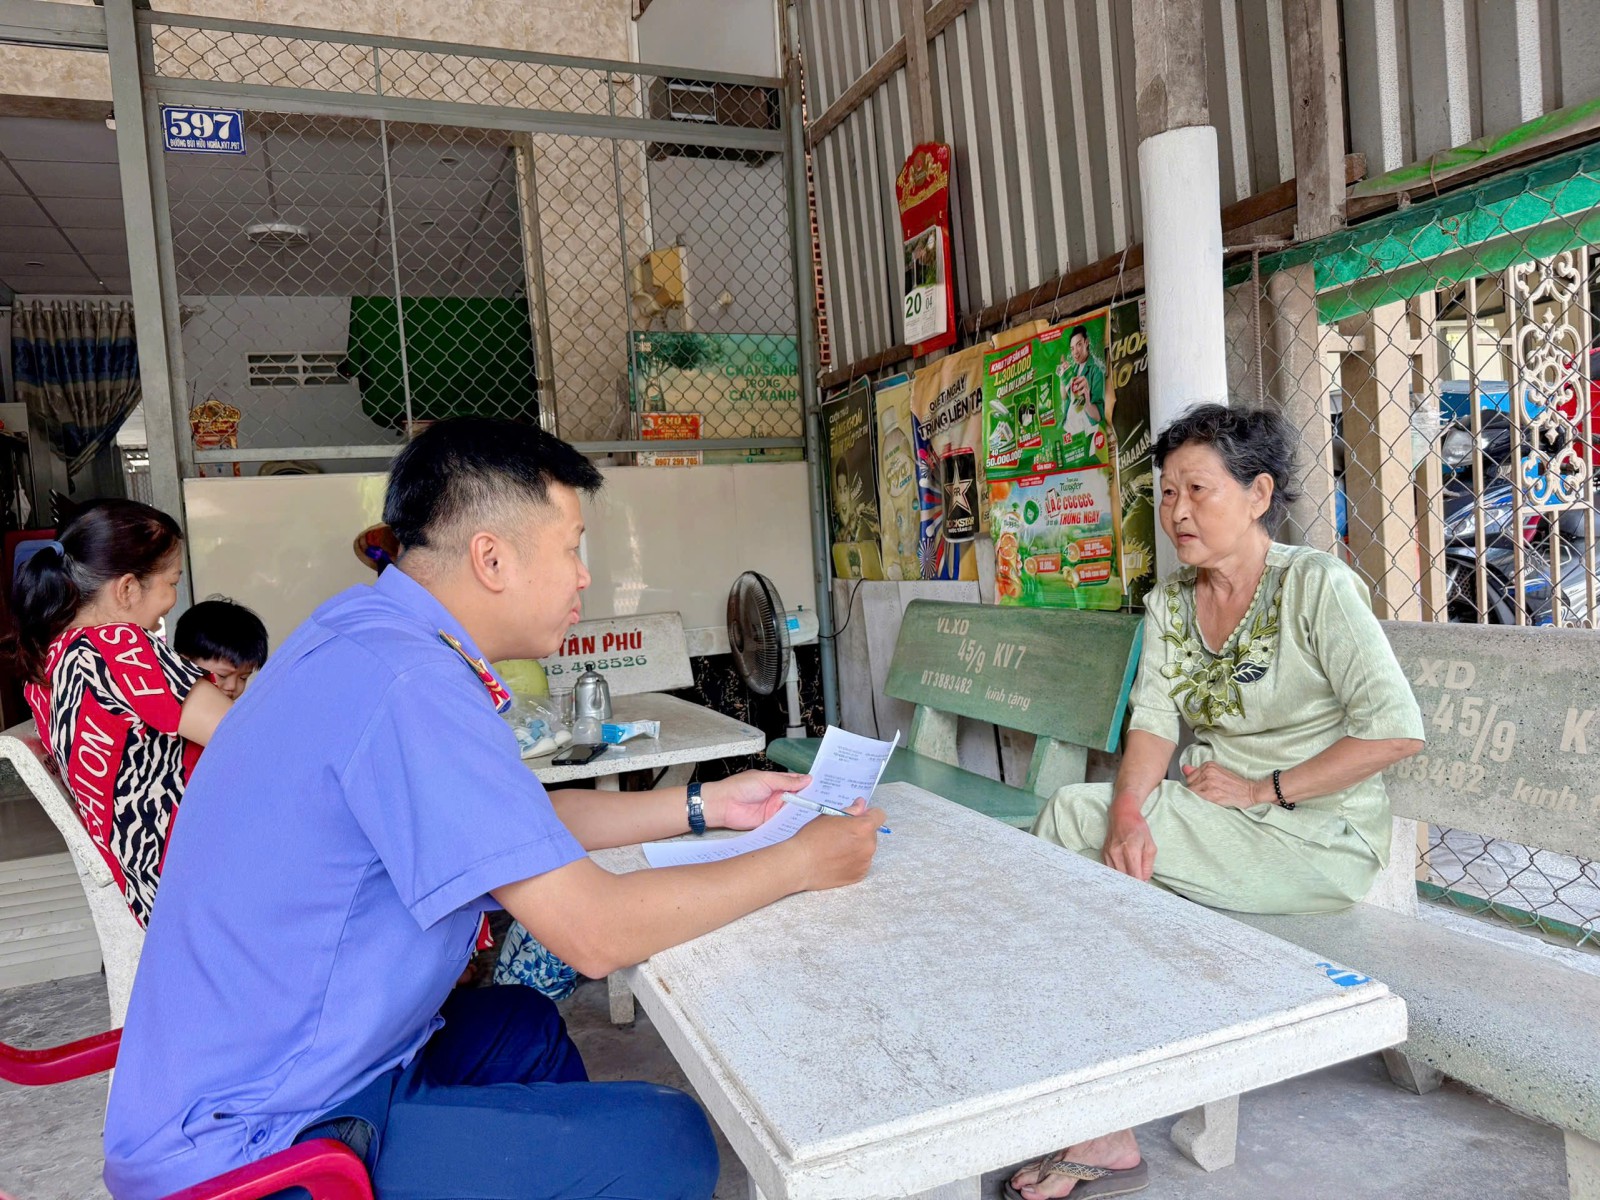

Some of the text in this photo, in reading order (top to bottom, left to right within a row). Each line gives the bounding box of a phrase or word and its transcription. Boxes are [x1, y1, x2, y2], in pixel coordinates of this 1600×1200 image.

[169, 111, 234, 140] 597
[905, 292, 922, 319] 20
[936, 616, 970, 637] VLXD
[558, 627, 643, 657] TÂN PHÚ
[957, 637, 986, 674] 45/9
[98, 622, 165, 697] FAS
[1431, 692, 1517, 764] 45/9
